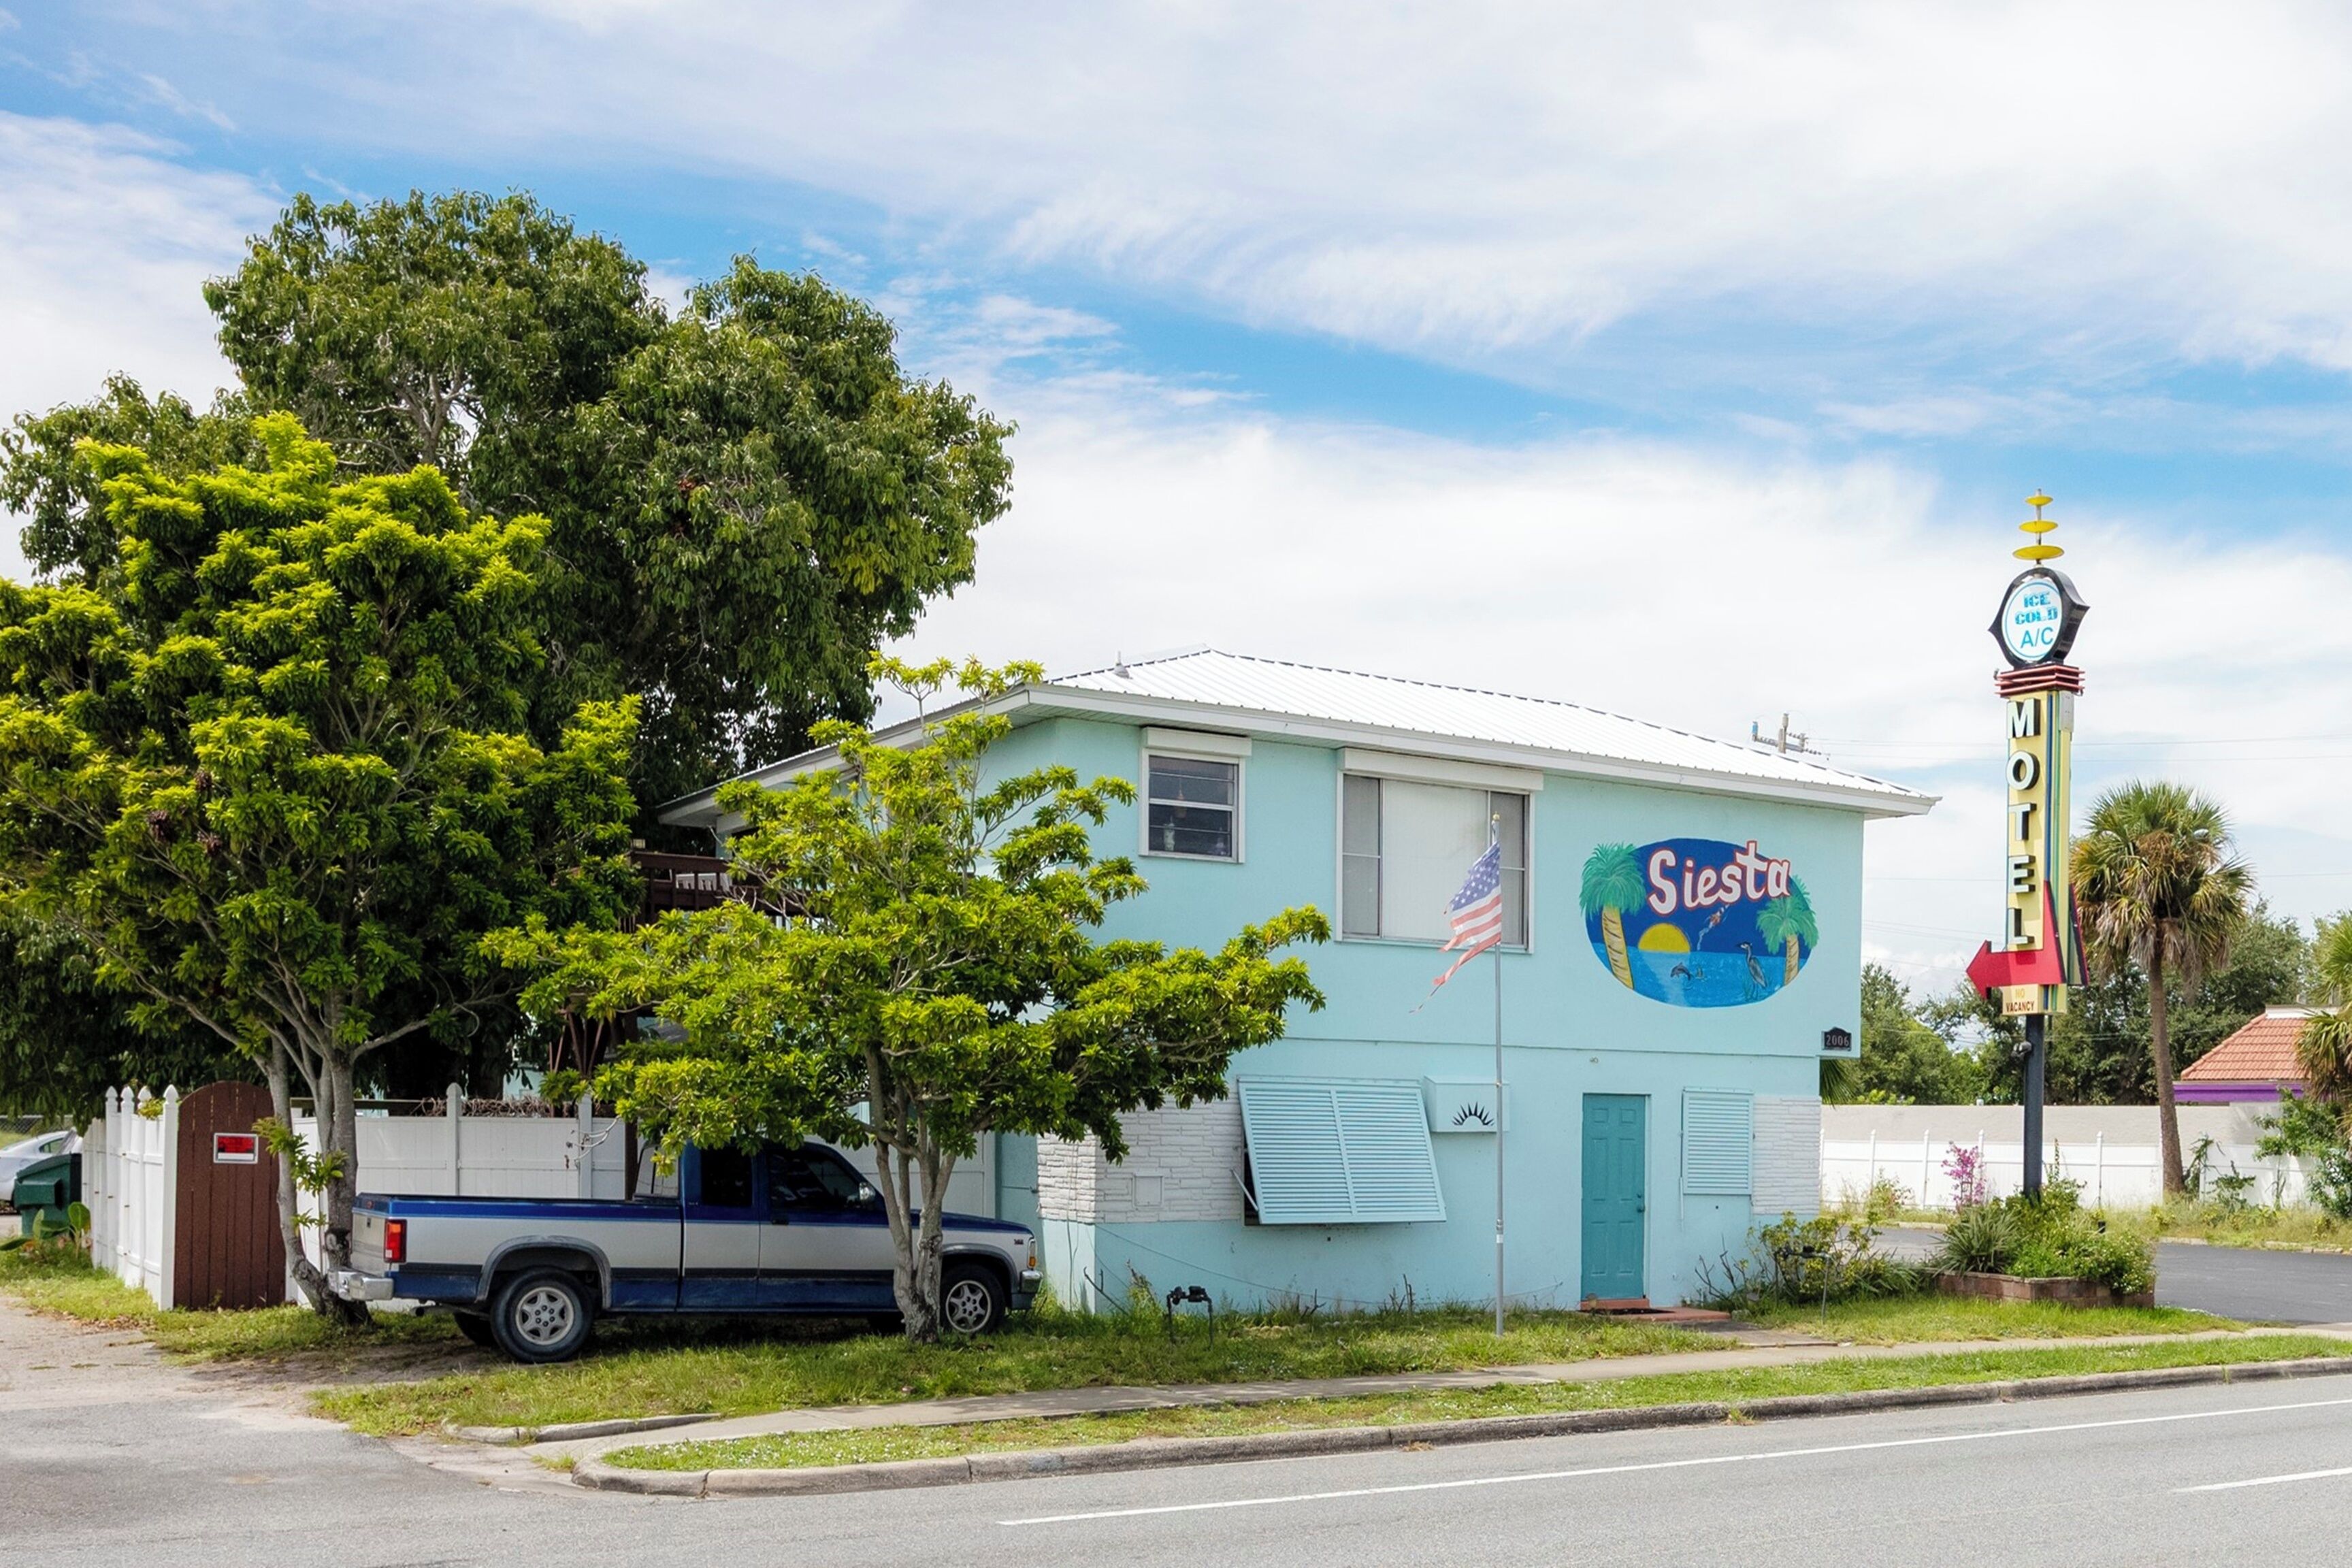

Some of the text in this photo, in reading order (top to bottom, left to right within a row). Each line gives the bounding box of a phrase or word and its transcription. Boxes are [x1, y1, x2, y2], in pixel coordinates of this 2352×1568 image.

[2023, 591, 2051, 608] ICE
[2015, 606, 2058, 625] COLD
[2020, 626, 2054, 649] A/C
[2006, 698, 2040, 945] MOTEL
[1647, 840, 1791, 917] Siesta
[2015, 988, 2025, 999] NO
[2006, 1000, 2035, 1013] VACANCY
[1826, 1034, 1850, 1047] 2006
